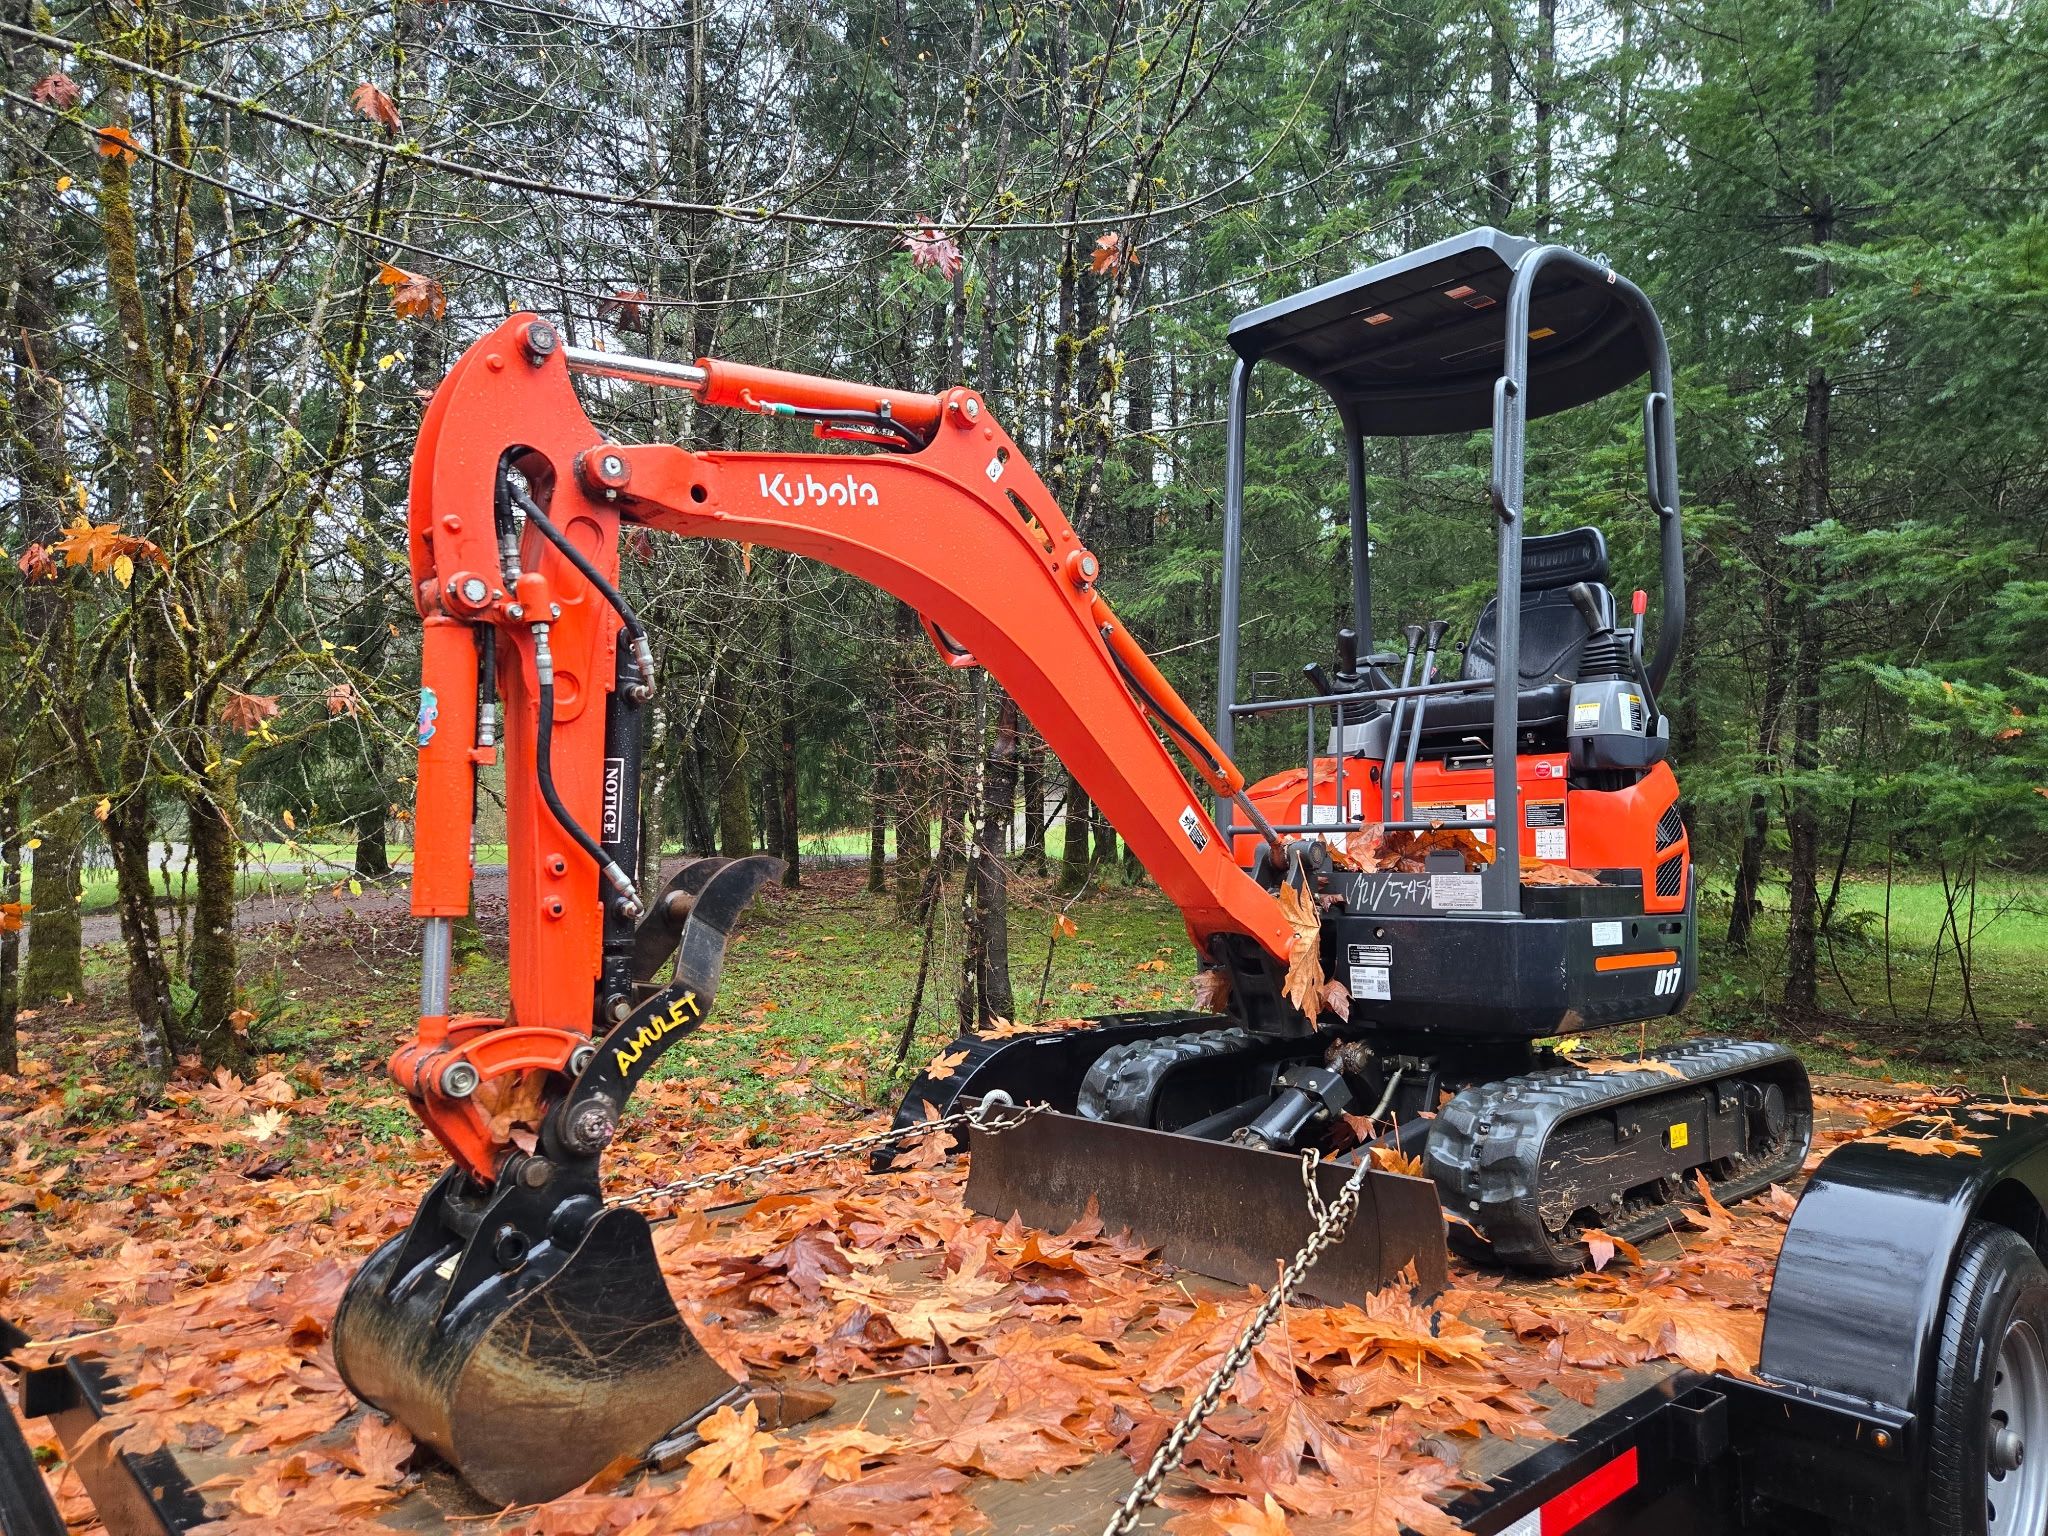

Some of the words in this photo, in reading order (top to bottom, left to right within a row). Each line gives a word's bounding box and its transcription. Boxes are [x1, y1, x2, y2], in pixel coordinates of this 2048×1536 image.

[758, 473, 879, 507] Kubota
[603, 767, 619, 834] NOTICE
[1654, 967, 1681, 996] U17
[614, 991, 700, 1077] AMULET
